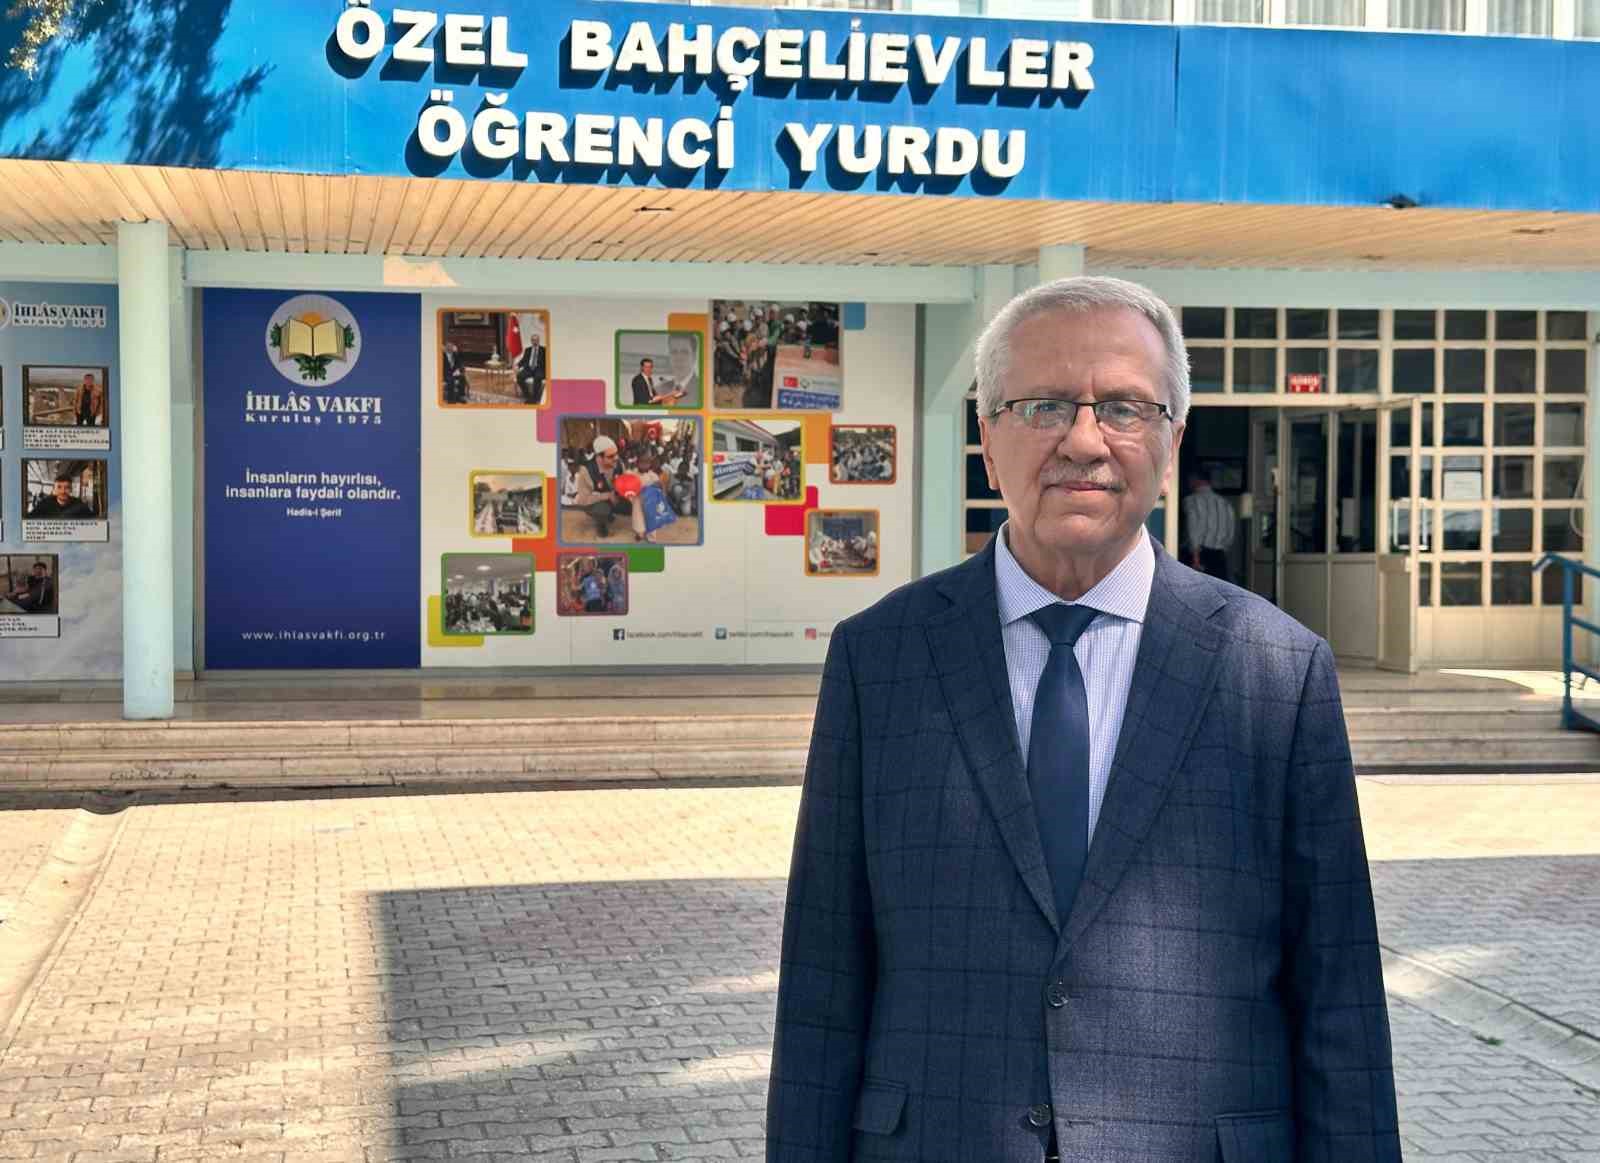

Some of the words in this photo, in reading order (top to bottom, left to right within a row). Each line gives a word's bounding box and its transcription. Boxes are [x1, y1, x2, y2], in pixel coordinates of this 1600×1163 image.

[336, 0, 528, 67] ÖZEL
[570, 18, 1095, 91] BAHÇELİEVLER
[418, 89, 735, 169] ÖĞRENCİ
[785, 122, 1026, 178] YURDU
[60, 306, 105, 319] VAKFI
[246, 390, 311, 412] İHLÂS
[316, 396, 382, 413] VAKFI
[245, 413, 321, 425] Kuruluş
[337, 414, 382, 425] 1975
[246, 468, 317, 485] İnsanların
[321, 472, 382, 488] hayırlısı,
[296, 486, 343, 501] faydalı
[347, 487, 401, 500] olandır.
[241, 629, 386, 642] www.ihlasvakfi.org.tr
